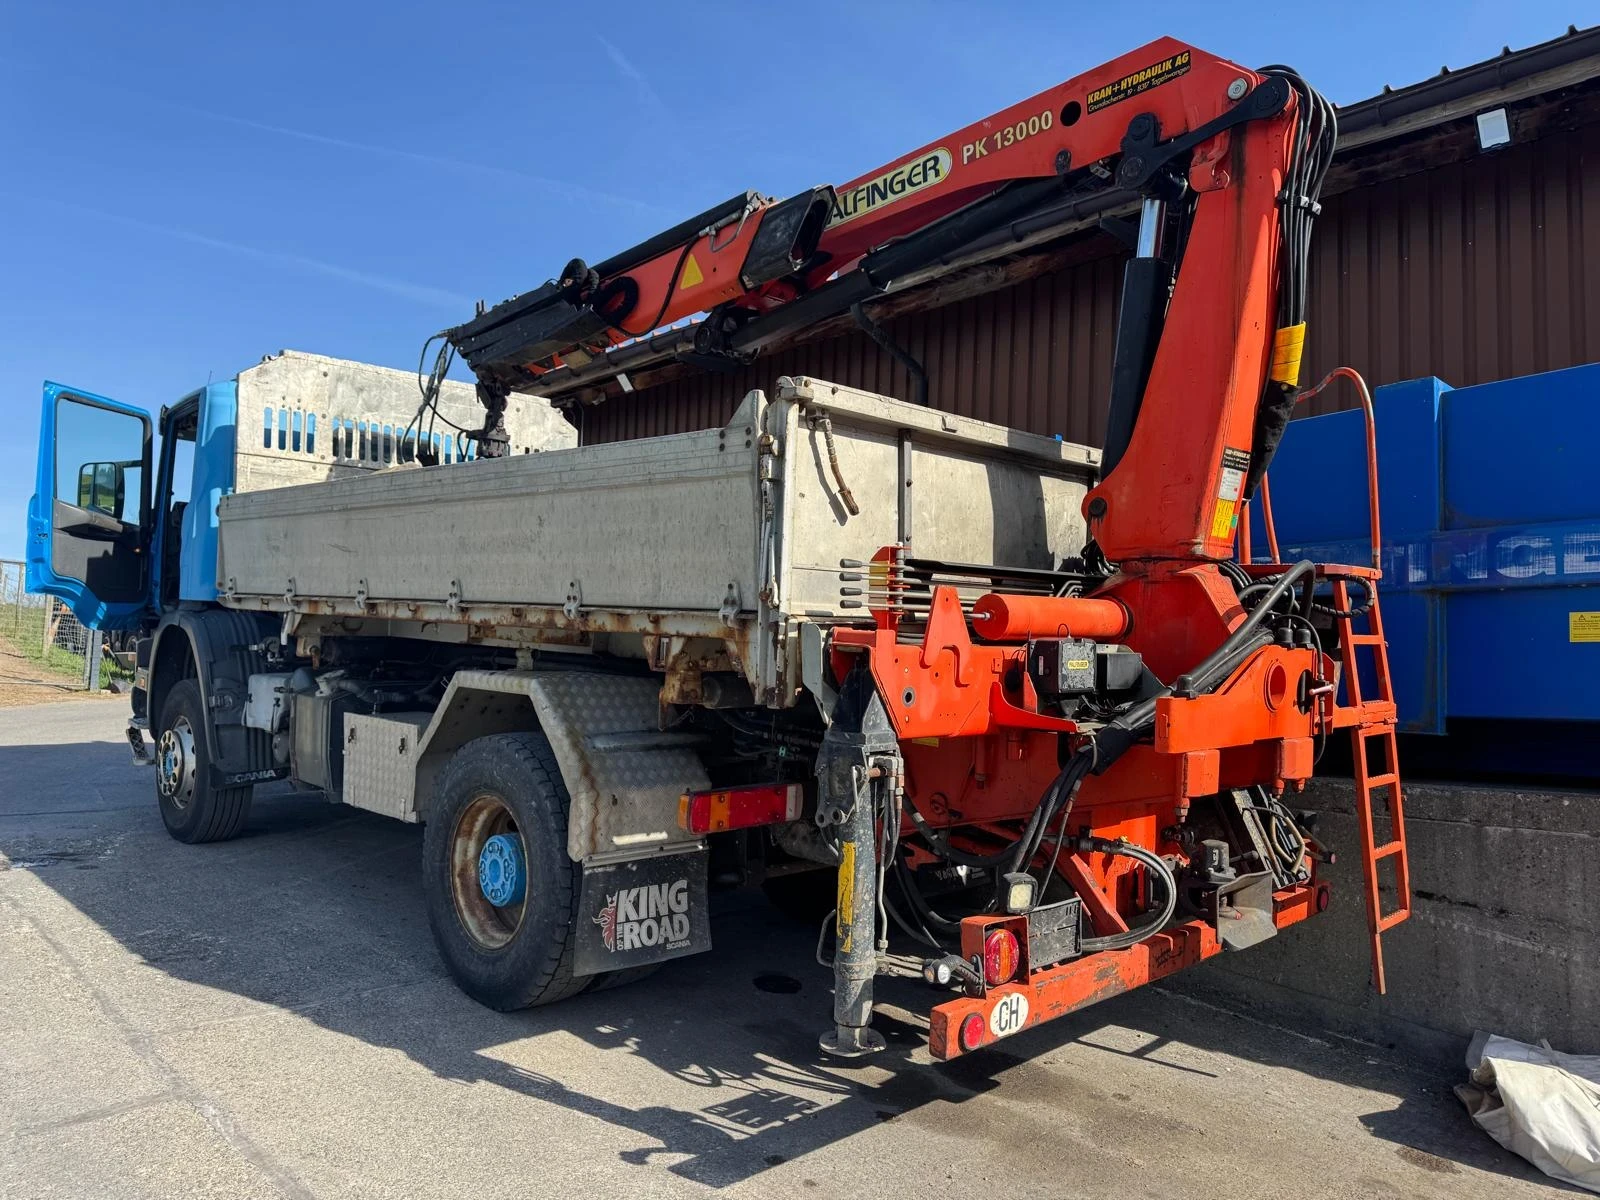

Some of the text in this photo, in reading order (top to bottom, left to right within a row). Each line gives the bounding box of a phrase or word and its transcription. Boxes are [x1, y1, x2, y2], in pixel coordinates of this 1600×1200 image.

[1174, 52, 1189, 67] AG
[962, 110, 1053, 165] PK 13000
[826, 155, 941, 226] ALFINGER
[224, 769, 277, 785] SCANIA
[617, 879, 688, 923] KING
[623, 913, 690, 951] ROAD
[998, 996, 1020, 1033] CH
